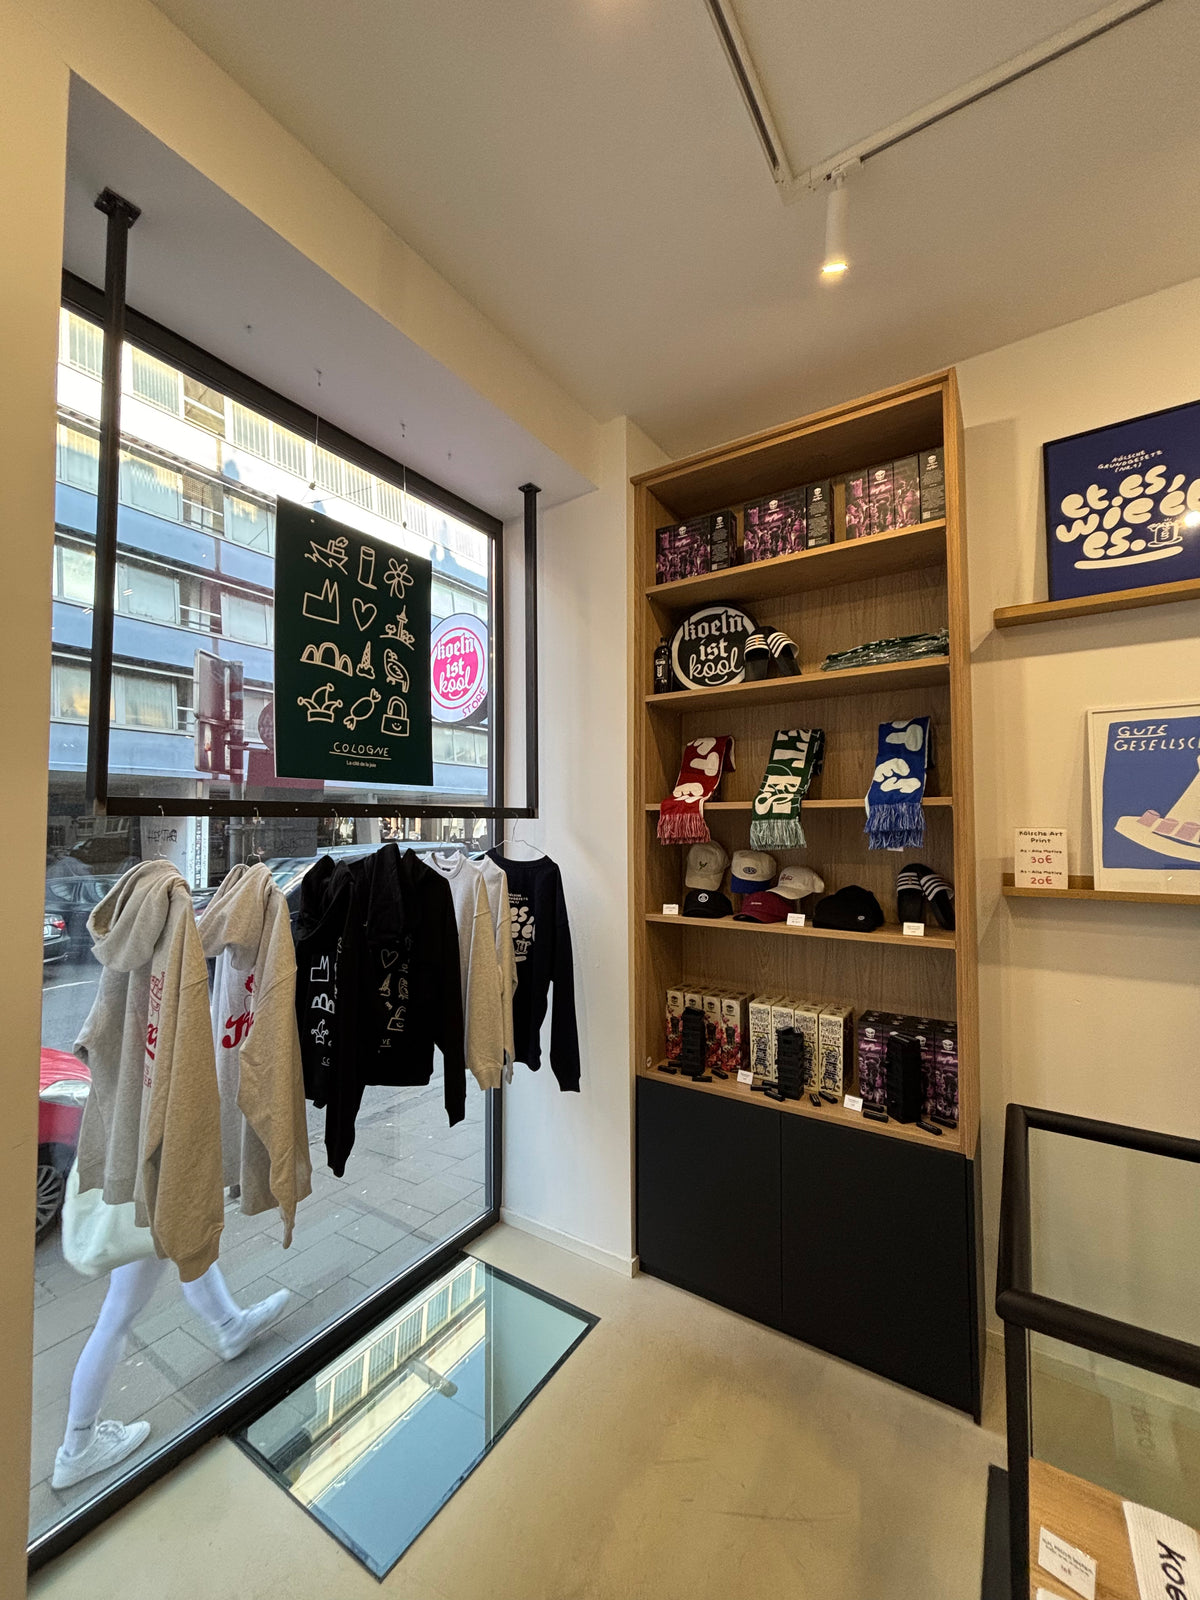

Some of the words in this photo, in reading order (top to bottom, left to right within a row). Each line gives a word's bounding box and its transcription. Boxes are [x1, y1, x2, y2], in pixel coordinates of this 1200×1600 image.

[1060, 484, 1110, 519] et
[1055, 496, 1154, 543] wie
[1082, 527, 1147, 559] es.
[683, 611, 744, 641] koeln
[436, 632, 476, 661] koeln
[699, 637, 729, 661] ist
[446, 657, 465, 679] ist
[689, 646, 744, 680] kool
[439, 665, 474, 695] kool
[462, 686, 487, 718] STORE
[1113, 737, 1200, 751] GESELLSC
[1117, 724, 1169, 737] GUTE
[333, 741, 390, 757] COLOGNE
[1031, 854, 1053, 864] 30€
[1030, 875, 1053, 885] 20€
